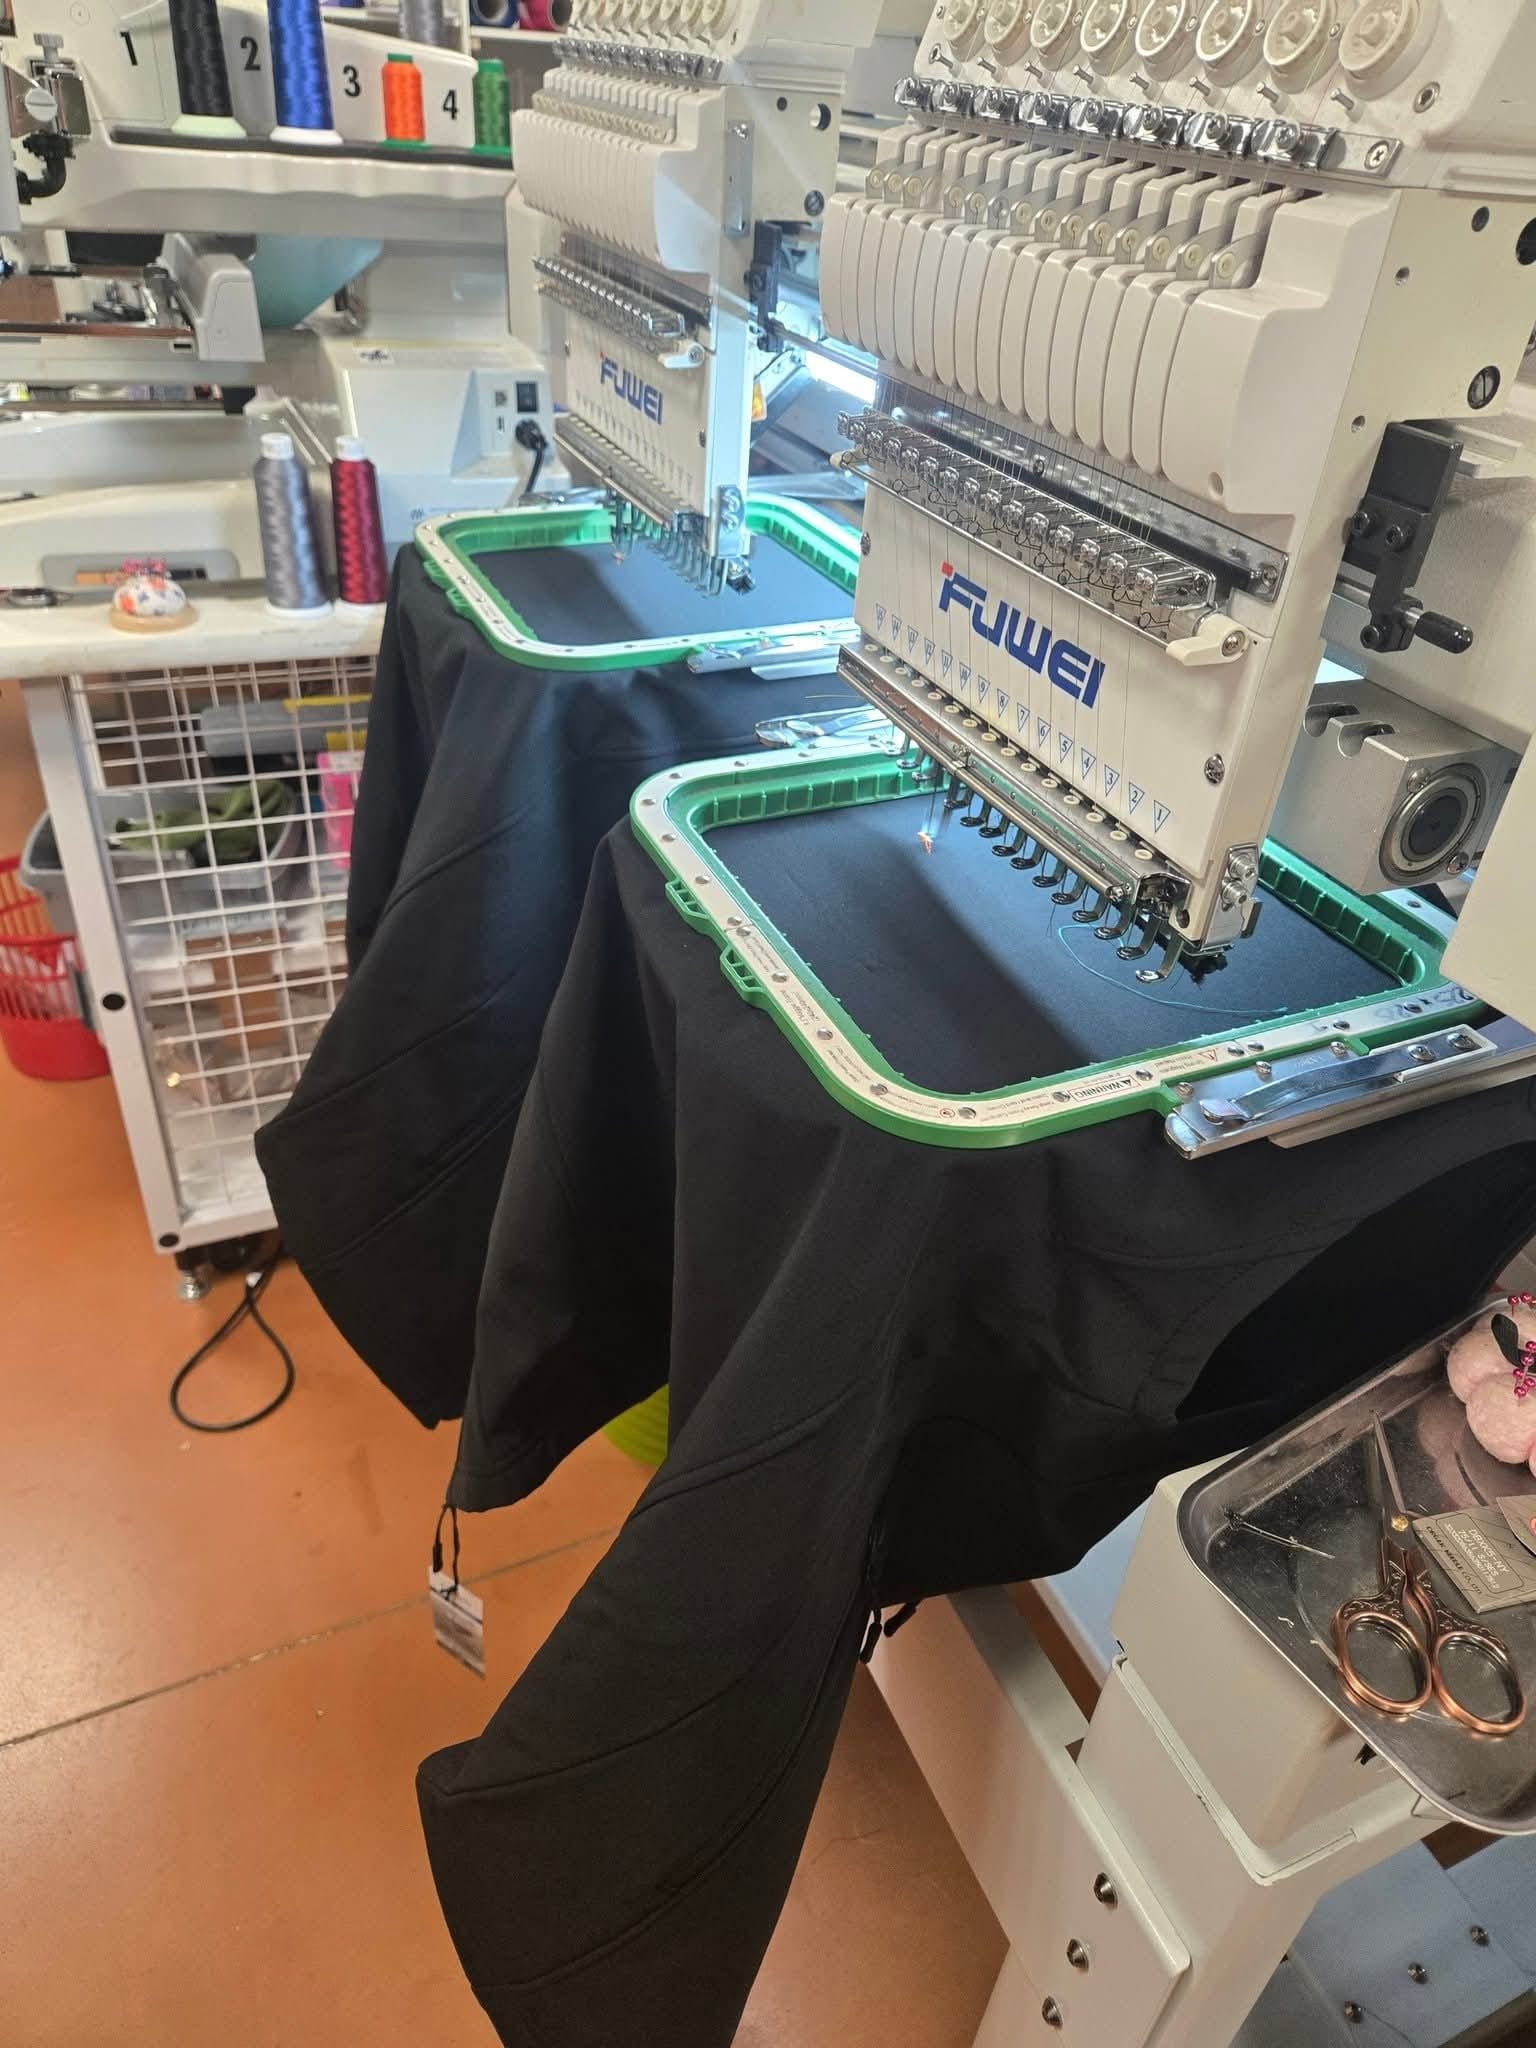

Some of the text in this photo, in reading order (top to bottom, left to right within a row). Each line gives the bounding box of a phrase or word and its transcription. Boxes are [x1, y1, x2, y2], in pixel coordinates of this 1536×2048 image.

[121, 31, 138, 66] 1
[240, 36, 261, 71] 2
[343, 65, 361, 97] 3
[442, 90, 459, 120] 4
[600, 355, 663, 425] FUWEI
[938, 566, 1106, 709] FUWEI
[1131, 790, 1138, 803] 2
[1075, 1080, 1123, 1098] WARNING
